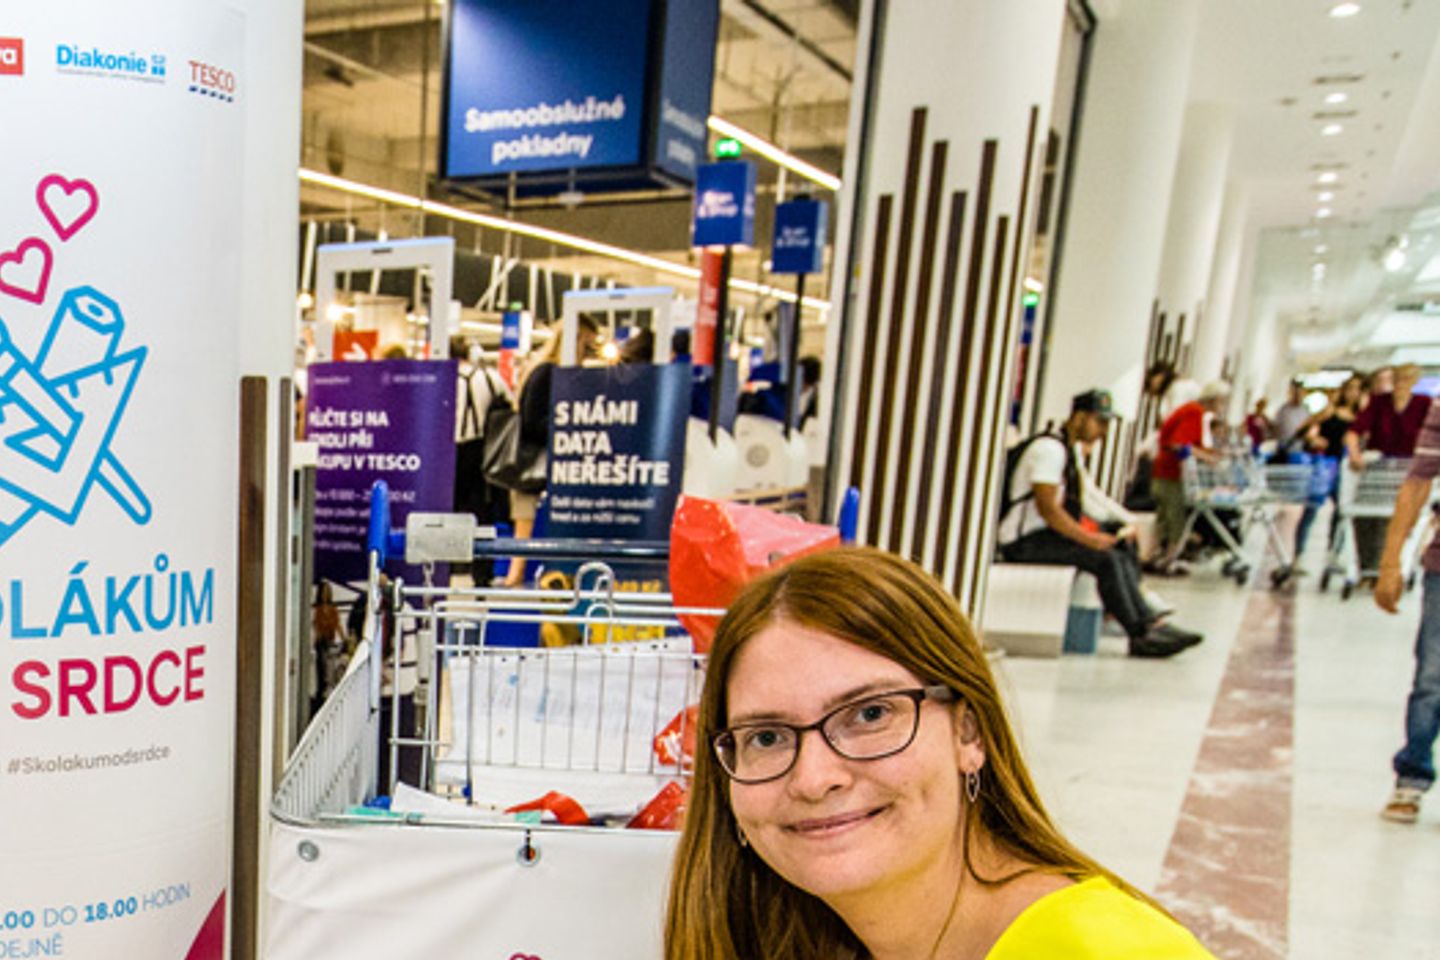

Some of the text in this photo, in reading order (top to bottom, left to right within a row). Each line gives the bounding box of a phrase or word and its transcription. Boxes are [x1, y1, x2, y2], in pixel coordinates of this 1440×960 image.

[56, 44, 147, 73] Diakonie
[189, 60, 235, 93] TESCO
[465, 94, 625, 133] Samoobslužné
[492, 134, 593, 166] pokladny
[365, 411, 390, 428] NA
[554, 394, 638, 425] S NÁMI
[553, 432, 613, 455] DATA
[354, 454, 365, 471] V
[367, 454, 421, 471] TESCO
[551, 453, 670, 485] NEŘEŠÍTE
[11, 645, 206, 720] SRDCE
[43, 906, 77, 927] DO
[84, 896, 139, 923] 18.00
[142, 882, 191, 912] HODIN
